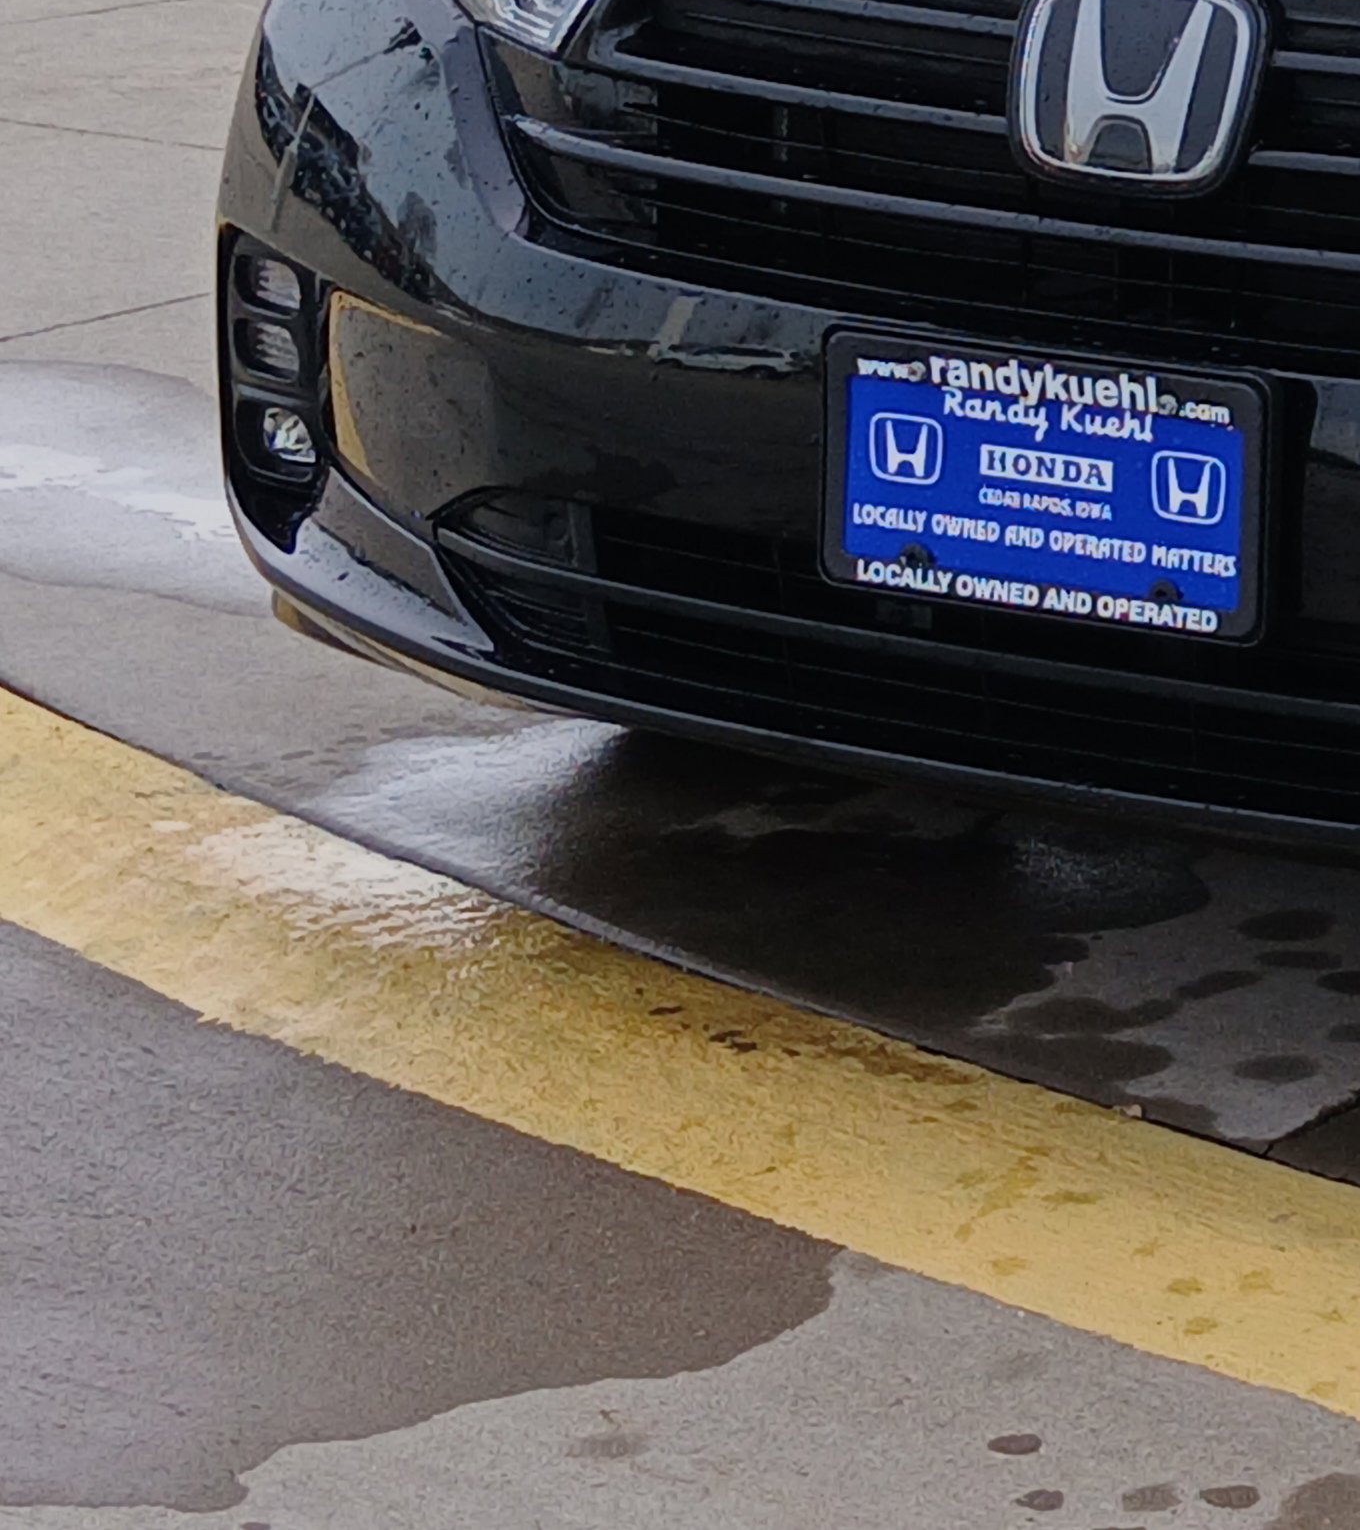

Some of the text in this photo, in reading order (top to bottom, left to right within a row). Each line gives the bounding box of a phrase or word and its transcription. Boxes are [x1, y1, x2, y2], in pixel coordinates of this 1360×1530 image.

[941, 386, 1153, 443] Randy Kuehl
[987, 450, 1106, 486] HONDA
[853, 503, 1237, 578] LOCALLY OWNED AND OPERATED MATTERS
[856, 558, 1218, 633] LOCALLY OWNED AND OPERATED
